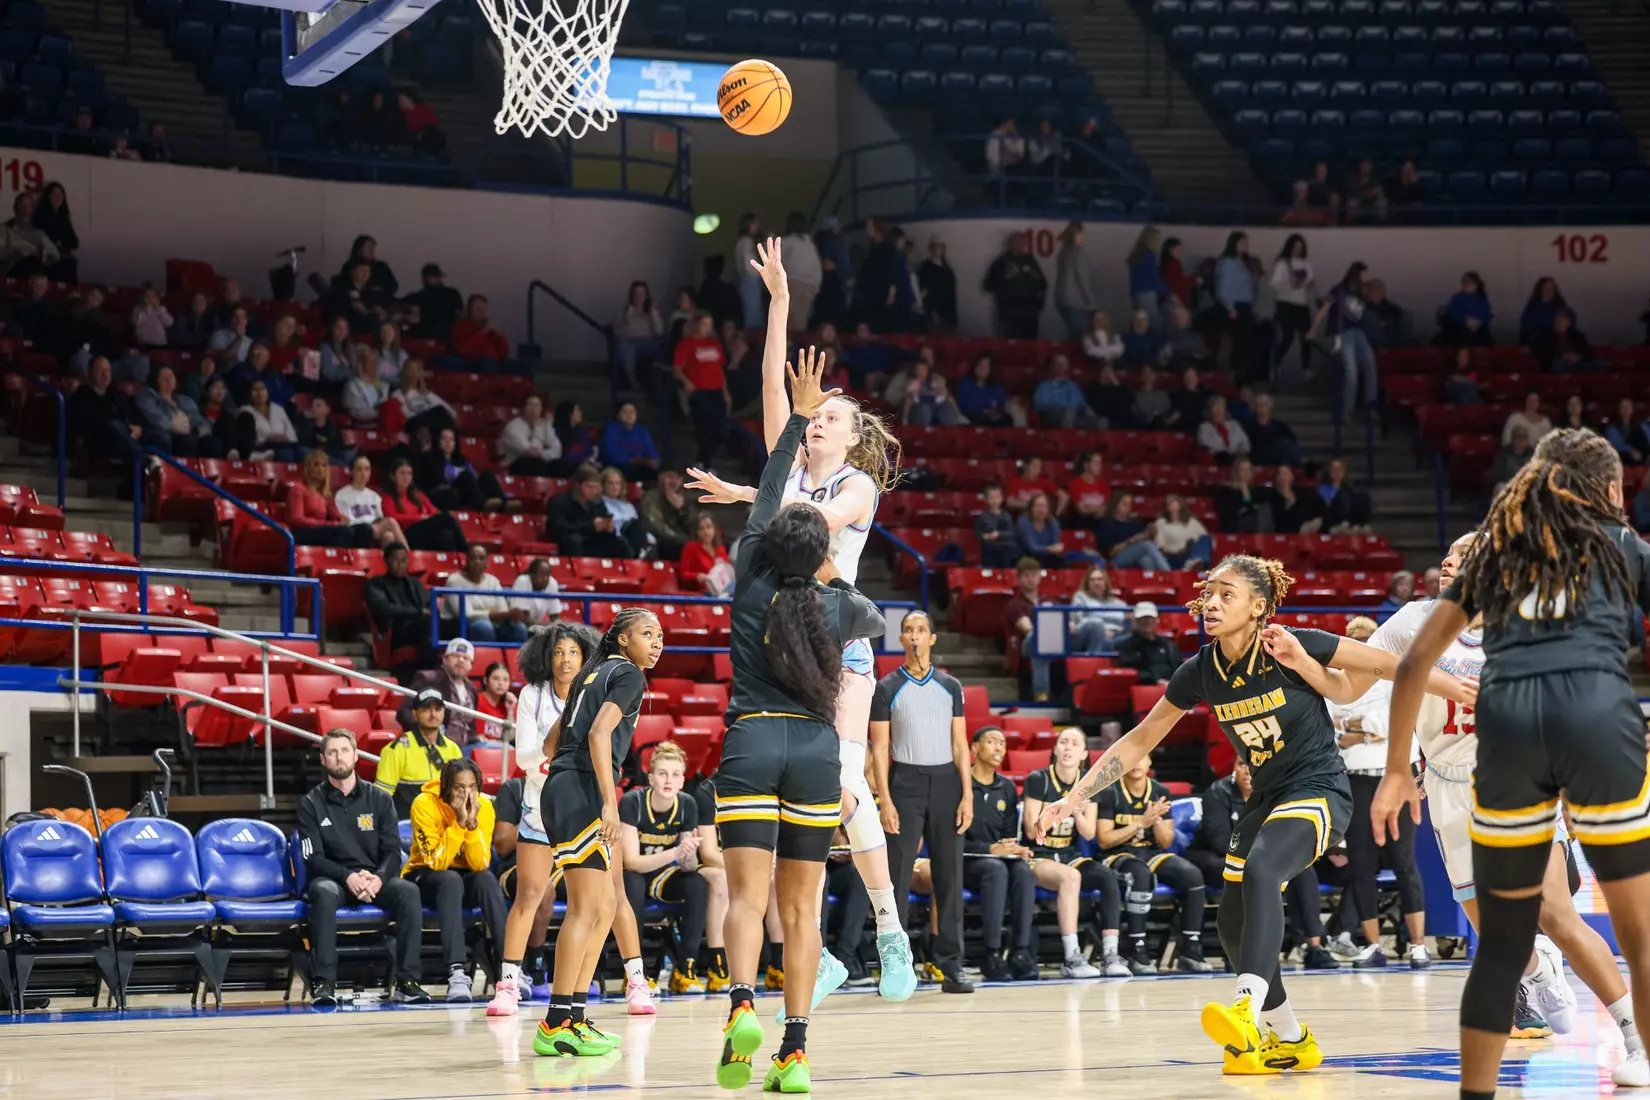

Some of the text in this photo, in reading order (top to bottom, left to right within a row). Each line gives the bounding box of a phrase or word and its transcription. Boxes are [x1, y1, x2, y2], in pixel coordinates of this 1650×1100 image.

[725, 98, 751, 123] NCAA
[0, 156, 44, 196] 19
[1551, 233, 1609, 263] 102
[1213, 686, 1287, 722] KENNESAW
[1232, 715, 1283, 750] 24
